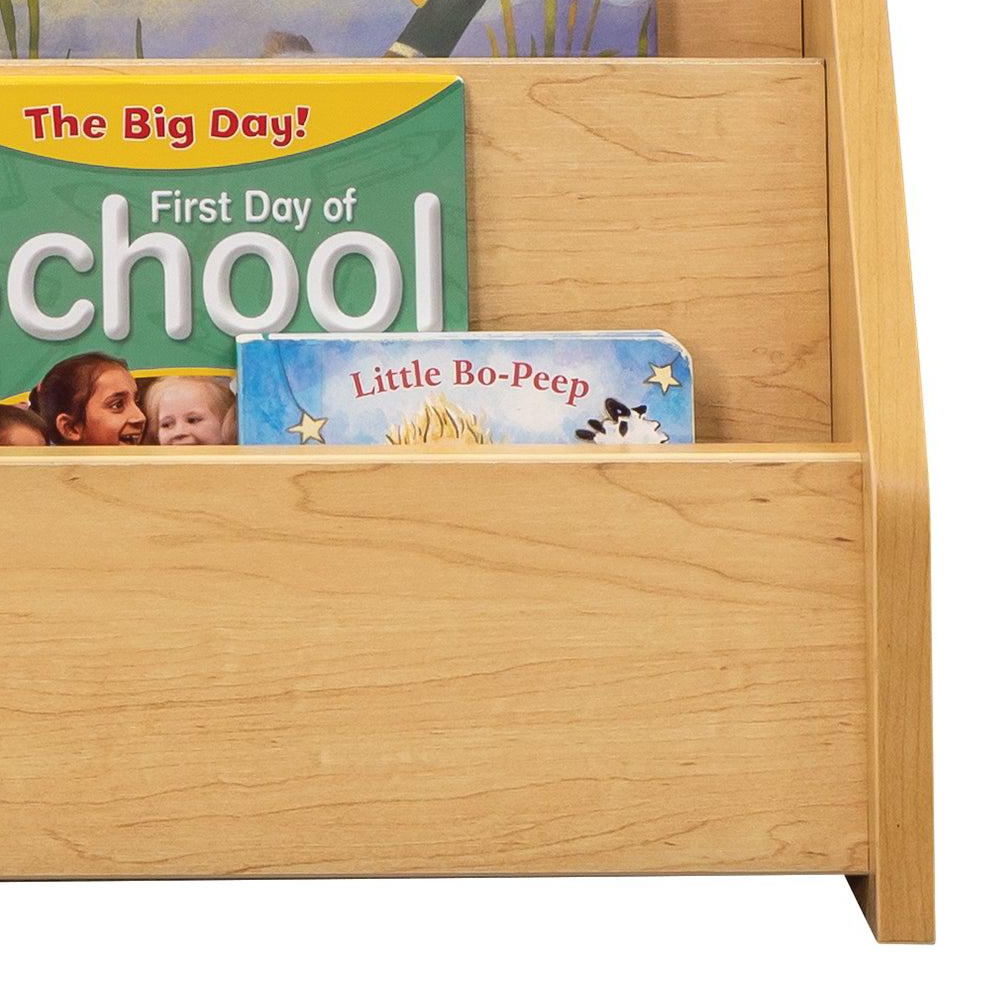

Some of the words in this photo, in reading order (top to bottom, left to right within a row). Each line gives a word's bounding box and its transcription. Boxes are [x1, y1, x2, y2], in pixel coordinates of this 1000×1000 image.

[24, 105, 107, 143] The
[122, 106, 196, 150] Big
[209, 105, 311, 150] Day!
[150, 189, 233, 225] First
[244, 191, 312, 232] Day
[323, 188, 358, 223] of
[349, 361, 442, 401] Little
[453, 358, 592, 408] Bo-Peep
